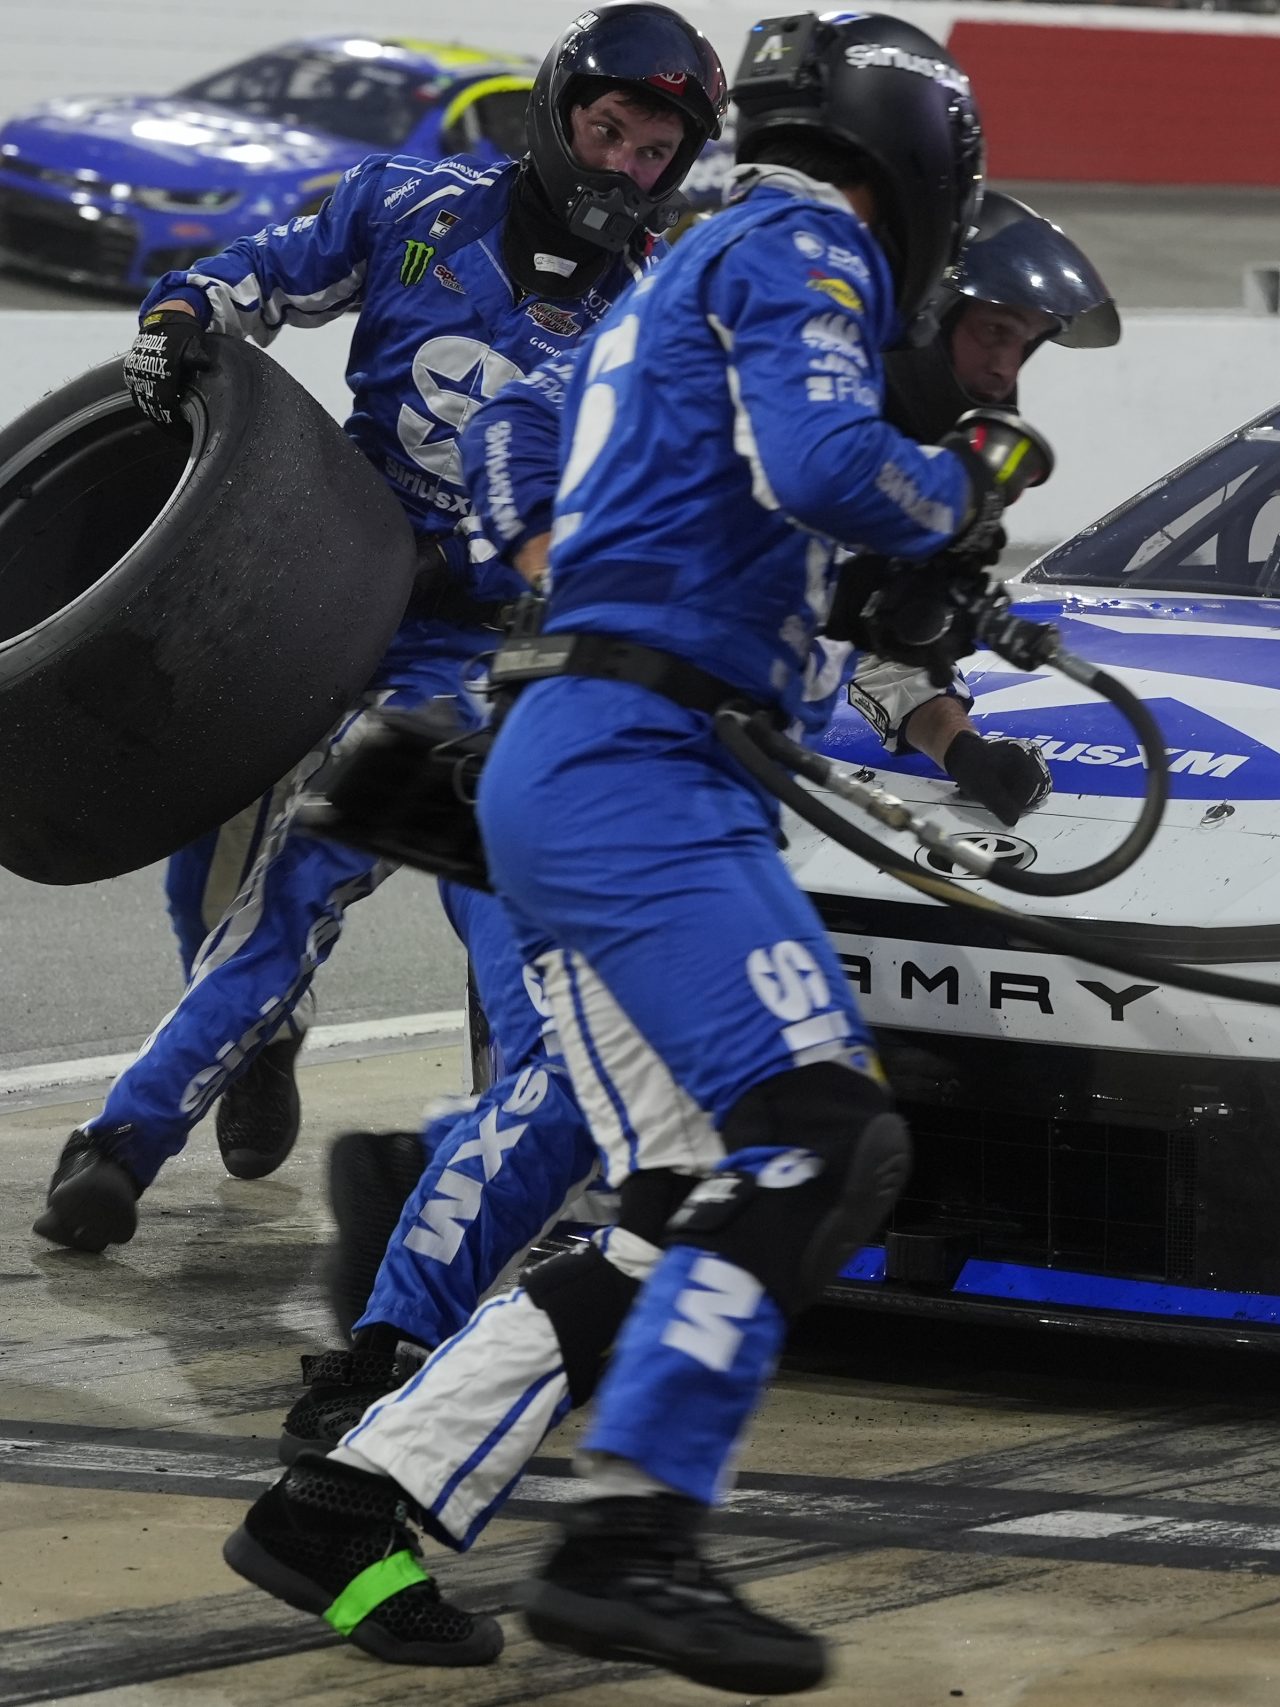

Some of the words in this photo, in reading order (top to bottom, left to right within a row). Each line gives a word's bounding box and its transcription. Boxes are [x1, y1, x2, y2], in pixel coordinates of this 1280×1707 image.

[384, 178, 422, 208] IMPACT
[529, 337, 563, 358] GOOD
[384, 455, 478, 517] SiriusX
[838, 953, 1161, 1022] AMRY
